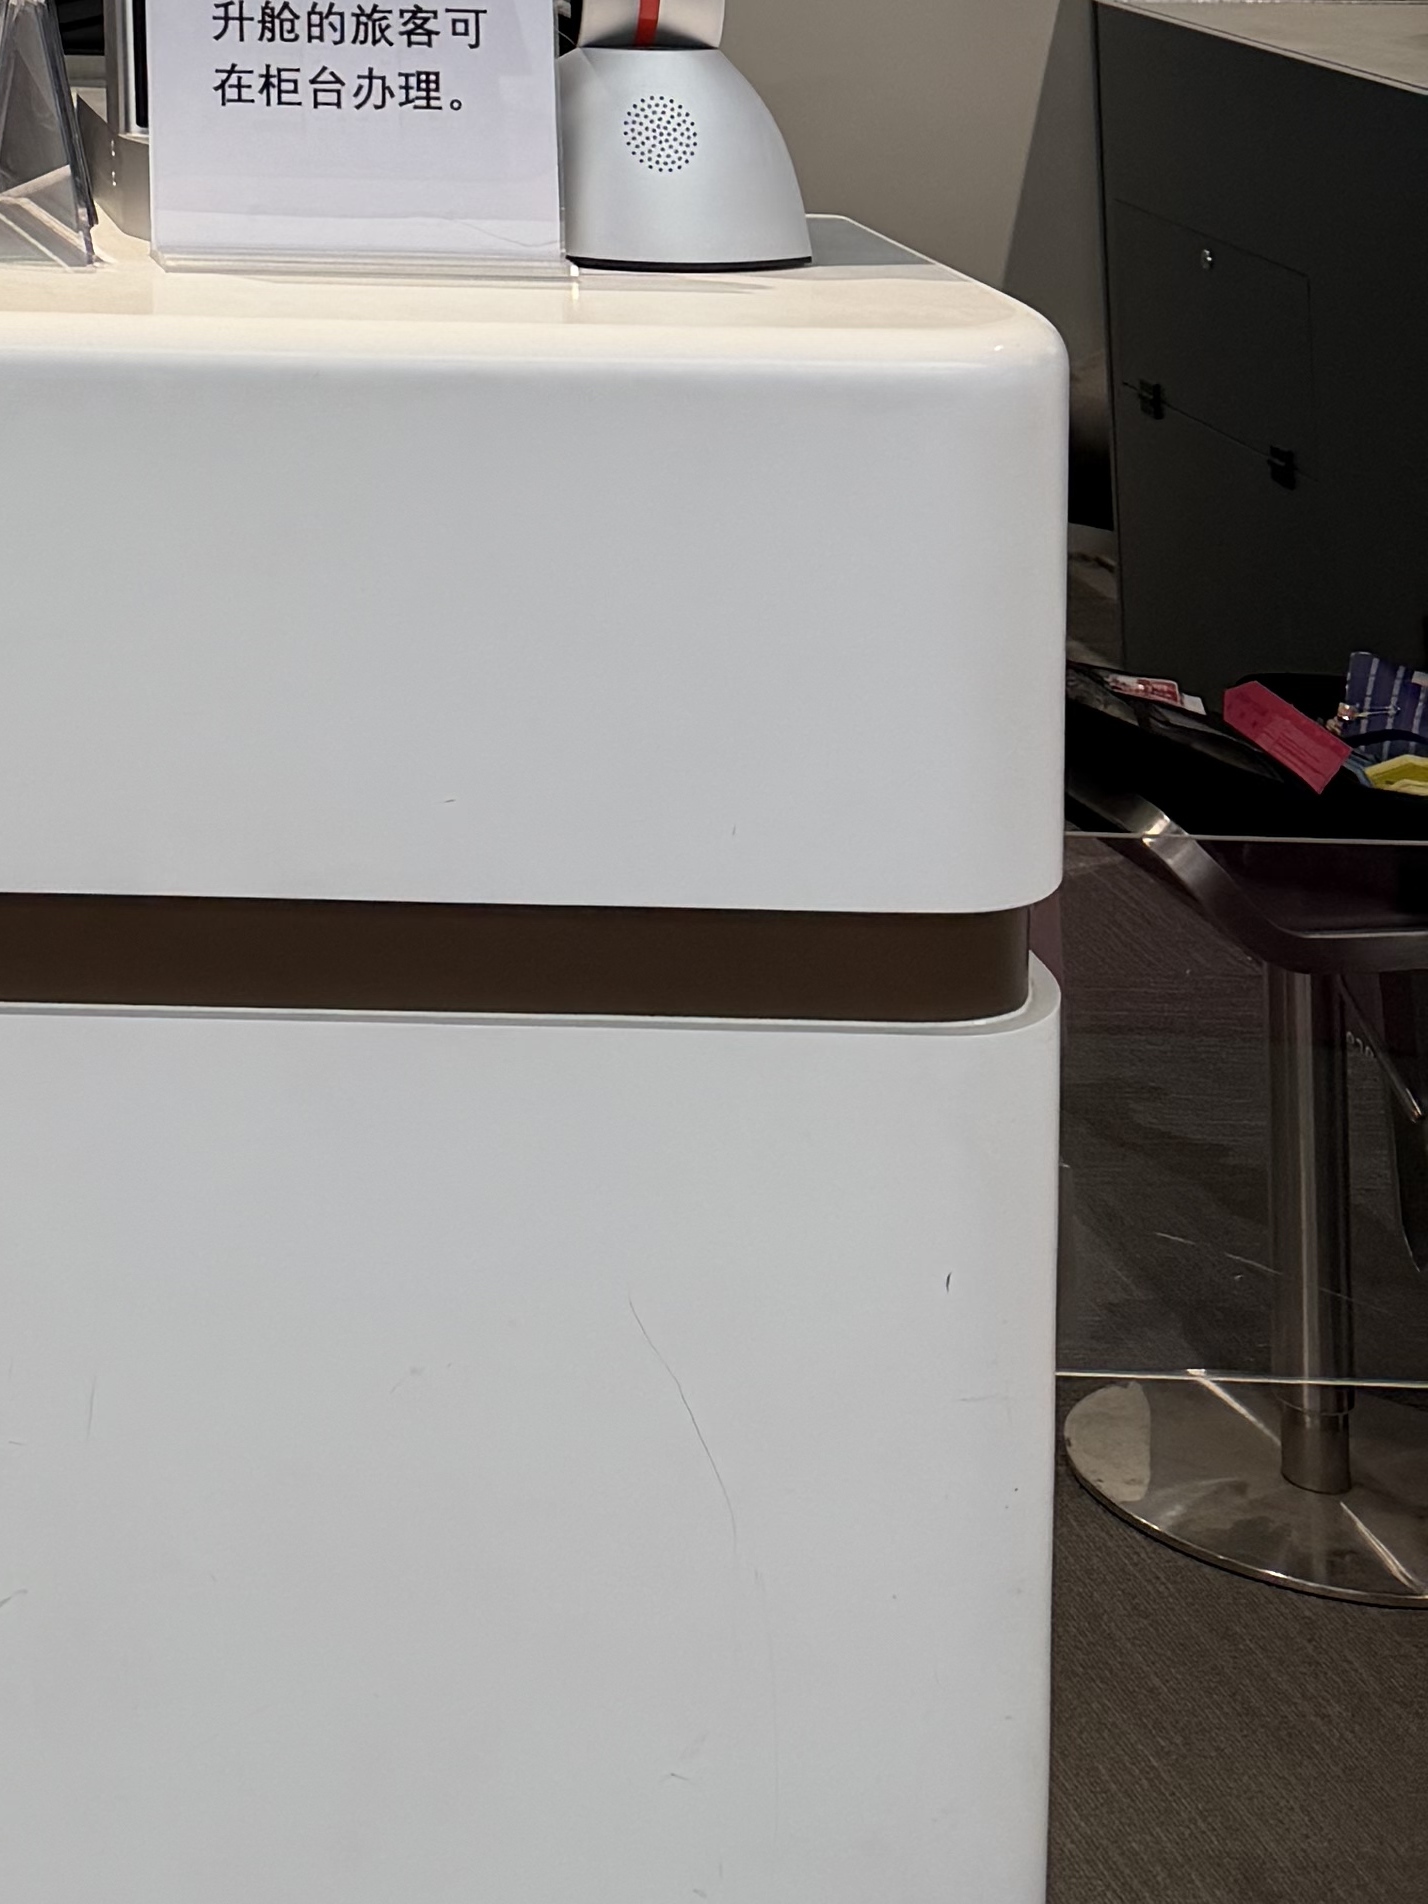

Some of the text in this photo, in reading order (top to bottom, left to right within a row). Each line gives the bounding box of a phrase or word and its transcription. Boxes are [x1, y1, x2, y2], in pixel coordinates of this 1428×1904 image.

[211, 0, 489, 51] 升舱的旅客可
[212, 61, 467, 114] 在柜台办理。
